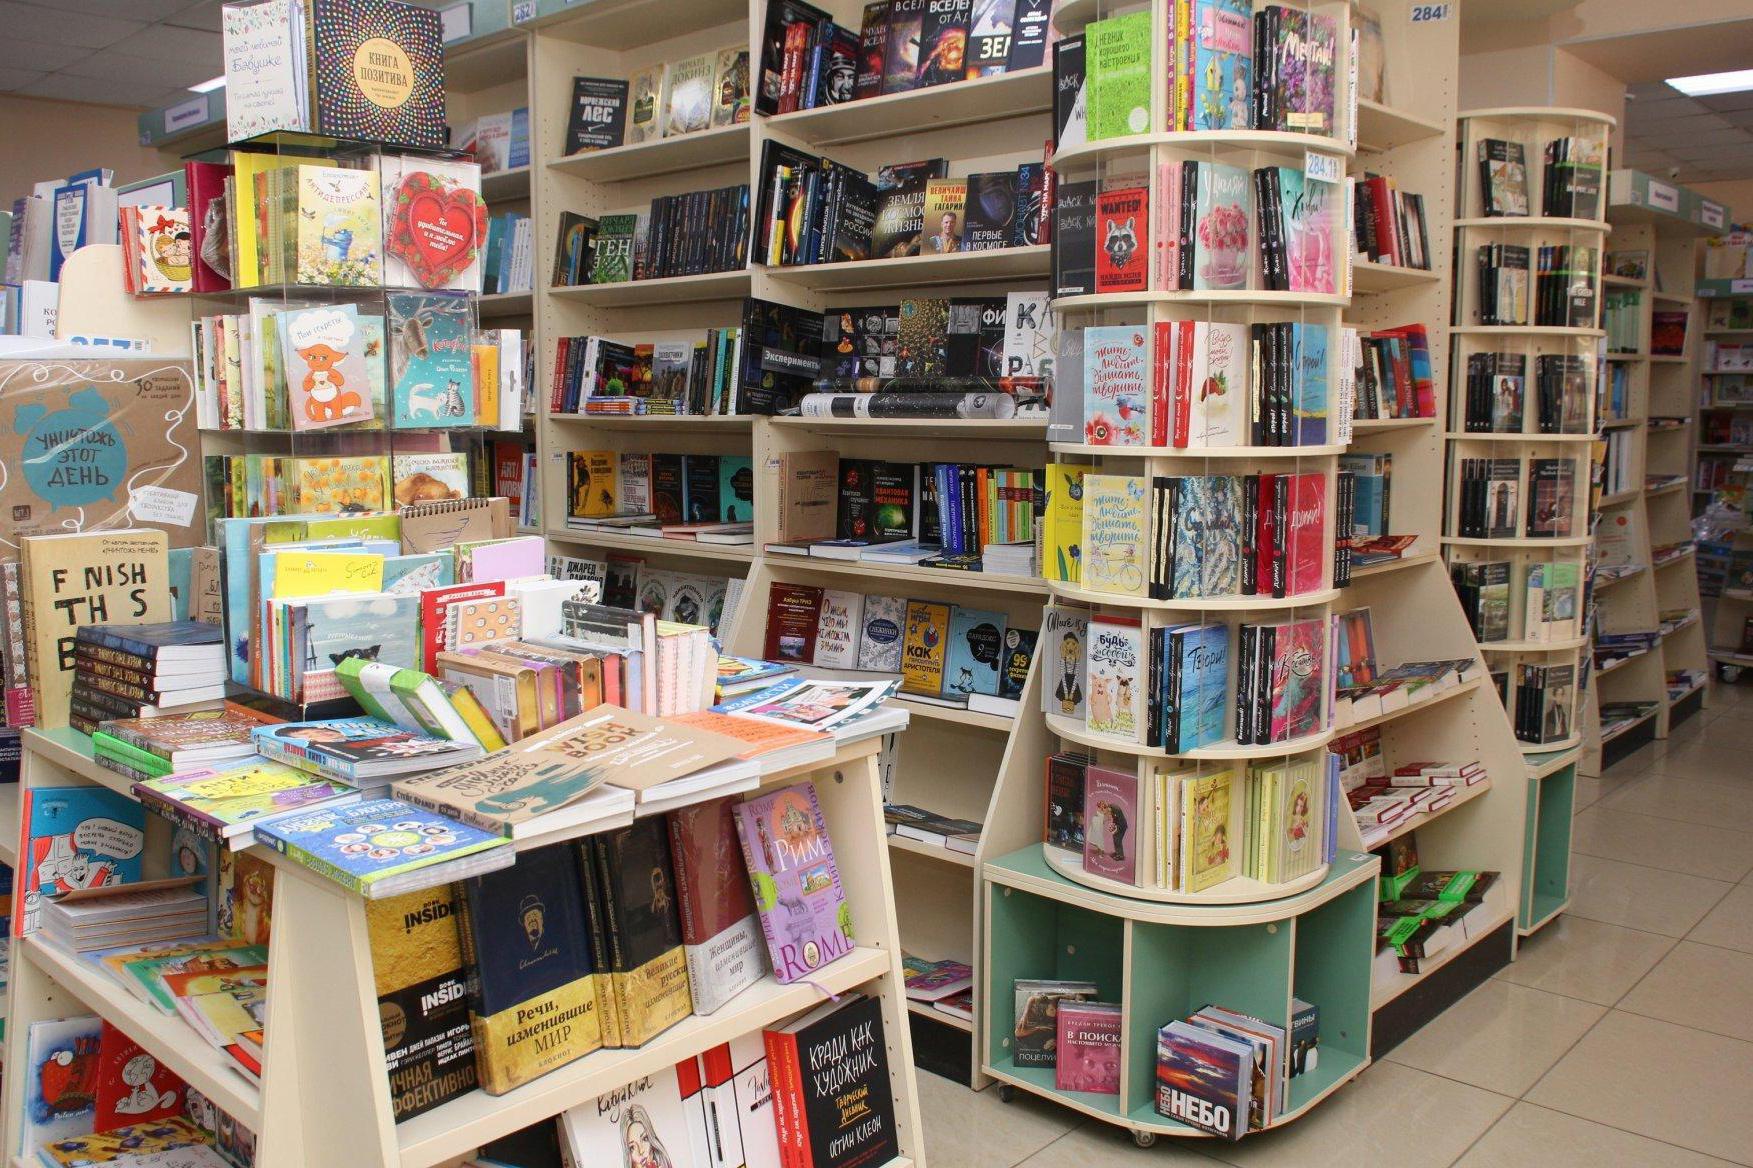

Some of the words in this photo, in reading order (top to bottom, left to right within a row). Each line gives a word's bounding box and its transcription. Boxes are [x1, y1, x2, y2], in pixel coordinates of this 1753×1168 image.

[1283, 31, 1334, 66] Мечтай!
[368, 51, 399, 70] КНИГА
[360, 66, 408, 88] ПОЗИТИВА
[888, 191, 926, 207] ЗЕМЛЯ
[1101, 200, 1141, 215] WANTED!
[883, 218, 924, 234] ЖИЗНЬ
[972, 230, 1003, 241] ПЕРВЫЕ
[36, 428, 116, 450] УНИЧТОЖЬ
[57, 449, 102, 464] ЭТОТ
[47, 465, 109, 487] ДЕНЬ
[875, 487, 909, 497] КВАНТОВАЯ
[1099, 634, 1126, 649] Будь
[773, 835, 826, 873] РИМ
[708, 929, 749, 960] Женщины,
[780, 926, 856, 980] ROME
[644, 954, 679, 979] Великие
[729, 959, 745, 978] мир
[506, 1000, 594, 1047] изменившие
[516, 1000, 560, 1025] Речи,
[446, 1023, 470, 1038] ИГОРЬ
[534, 1025, 572, 1055] МИР
[1067, 1031, 1074, 1039] В
[808, 1039, 848, 1071] КРАДИ
[850, 1020, 874, 1054] КАК
[813, 1047, 878, 1098] ХУДОЖНИК
[1159, 1085, 1171, 1115] НЕБО
[1171, 1090, 1230, 1132] НЕБО
[829, 1135, 855, 1159] ОСТИН
[855, 1115, 882, 1148] КЛЕОН
